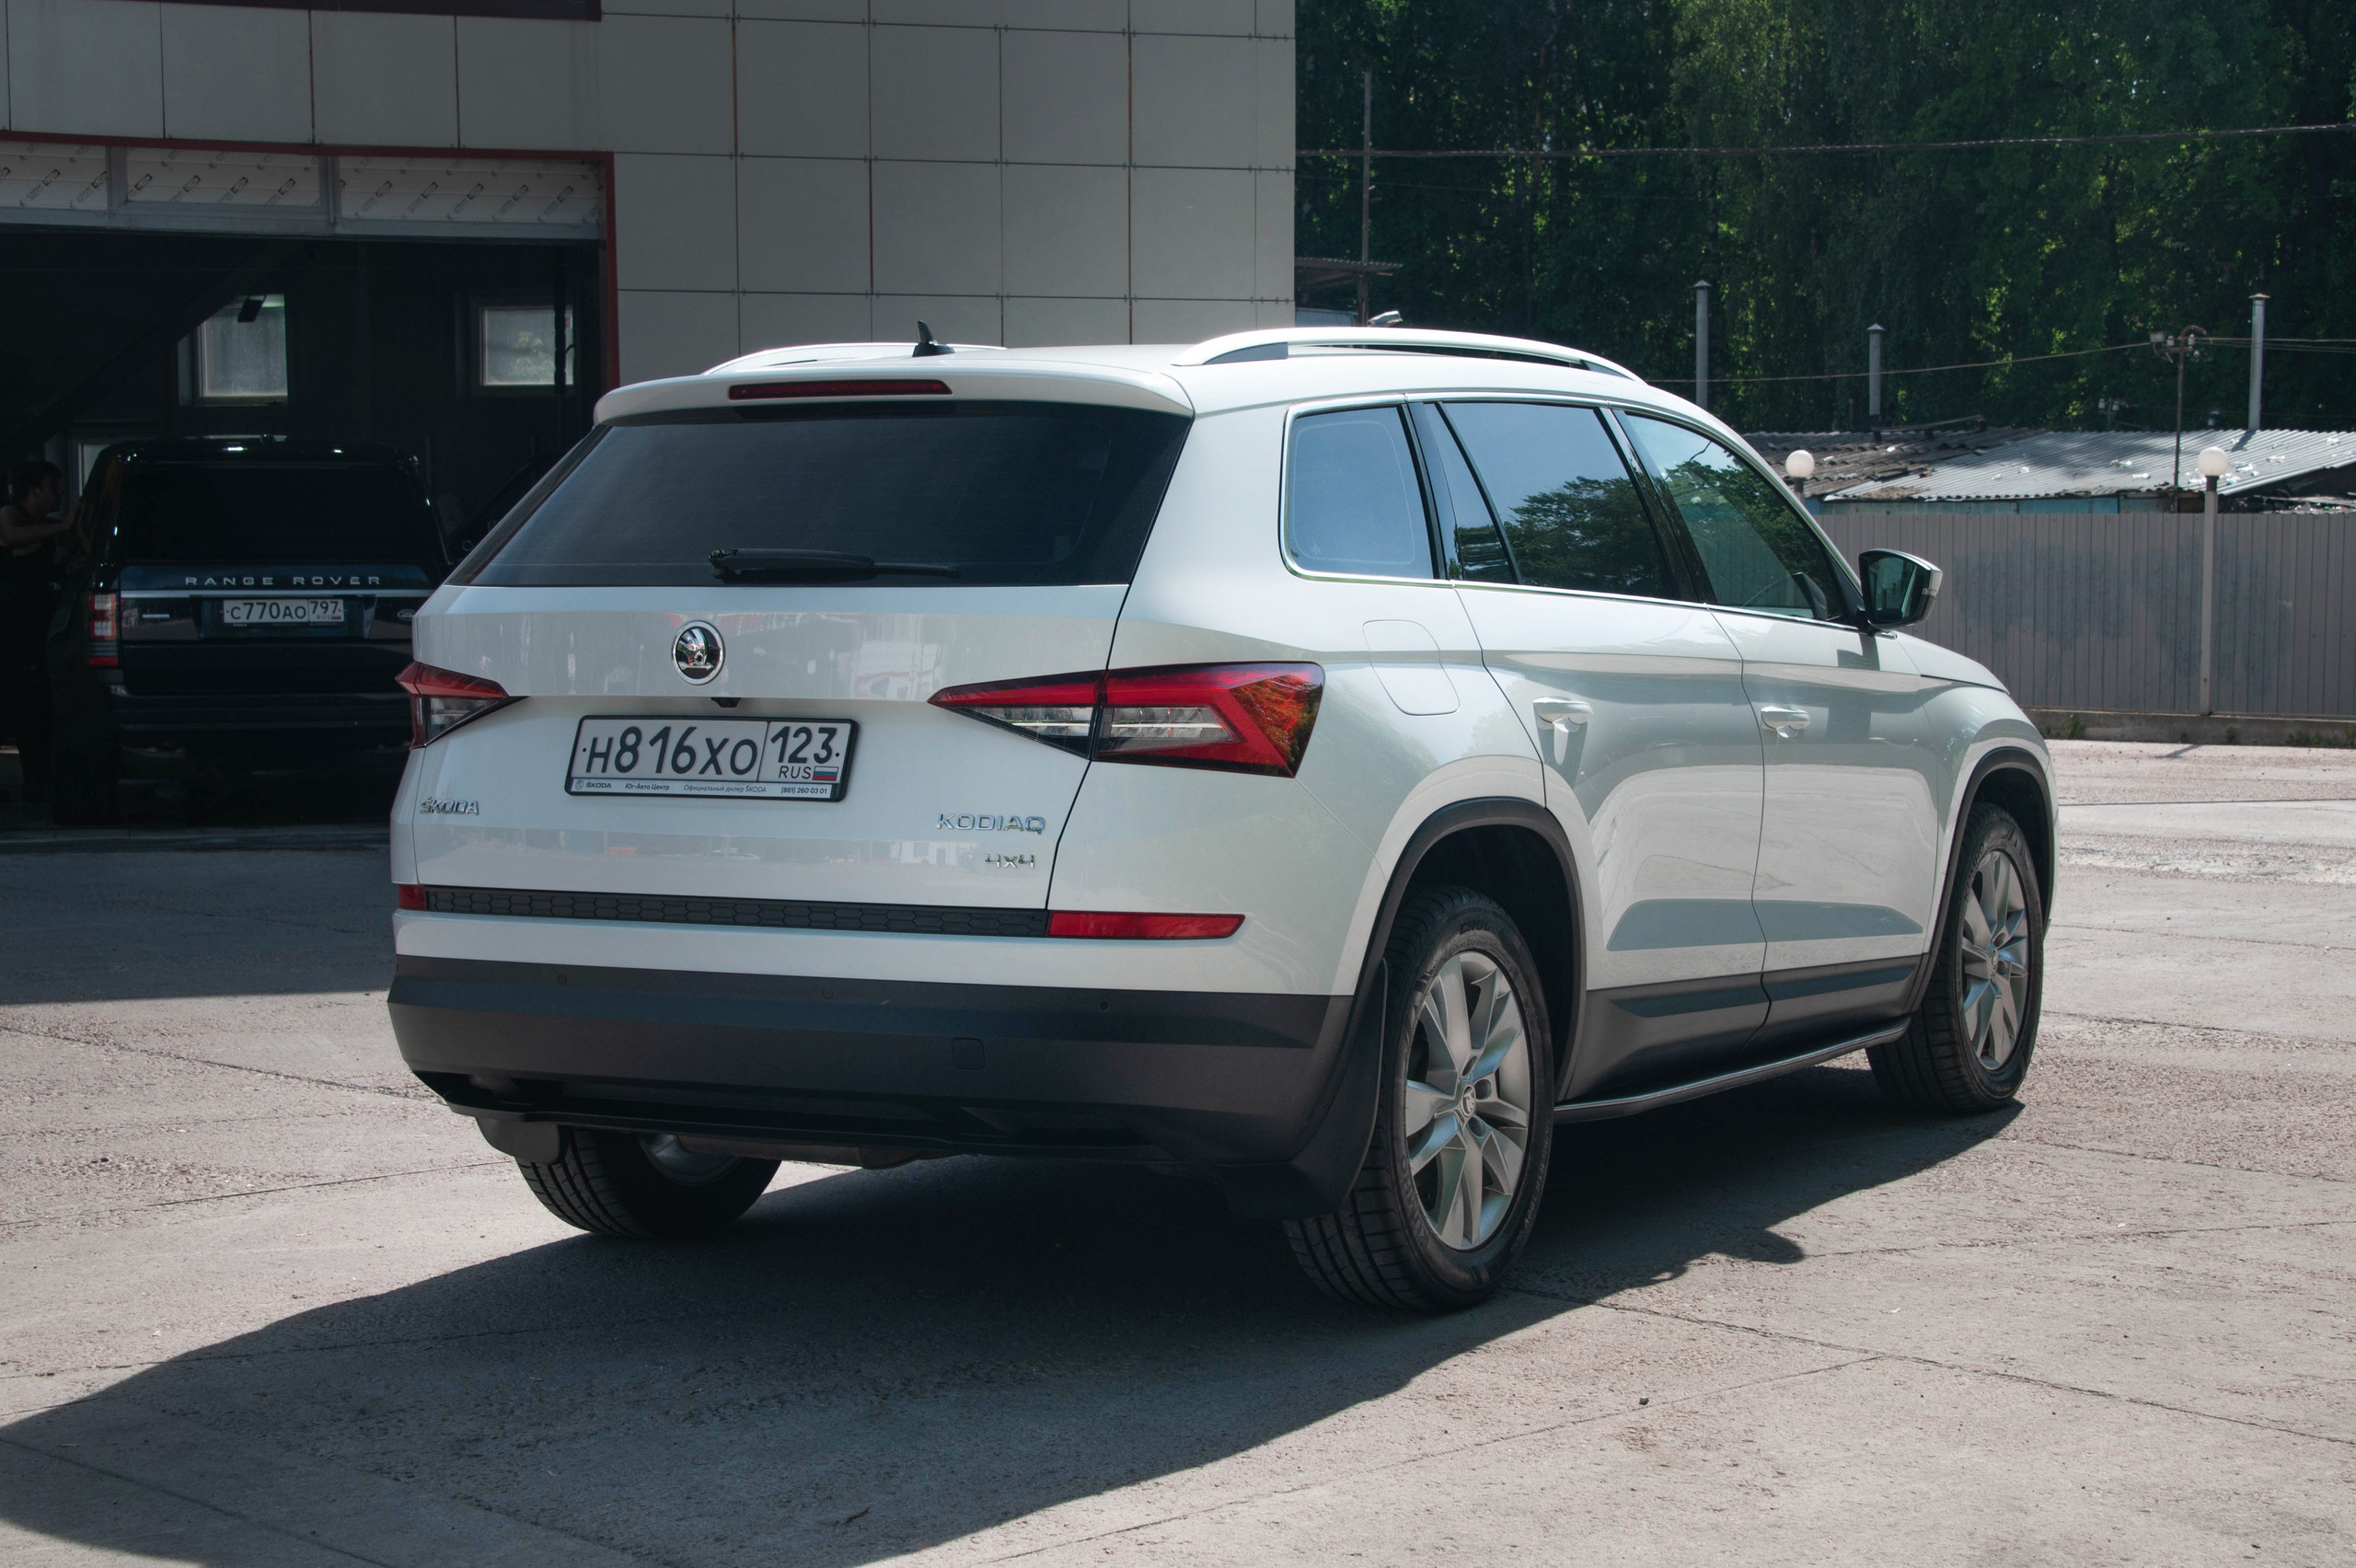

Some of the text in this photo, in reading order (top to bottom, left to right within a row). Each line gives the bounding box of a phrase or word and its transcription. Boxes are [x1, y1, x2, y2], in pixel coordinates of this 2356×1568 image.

[185, 576, 380, 586] RANGE ROVER
[310, 600, 339, 615] 797
[770, 726, 837, 765] 123
[779, 766, 812, 779] RUS
[652, 783, 670, 791] Центр
[684, 784, 725, 793] Официальный
[745, 784, 767, 792] ŠKODA
[420, 796, 479, 815] ŠKODA
[936, 813, 1045, 835] KODIAQ
[985, 854, 1034, 869] 4x4
